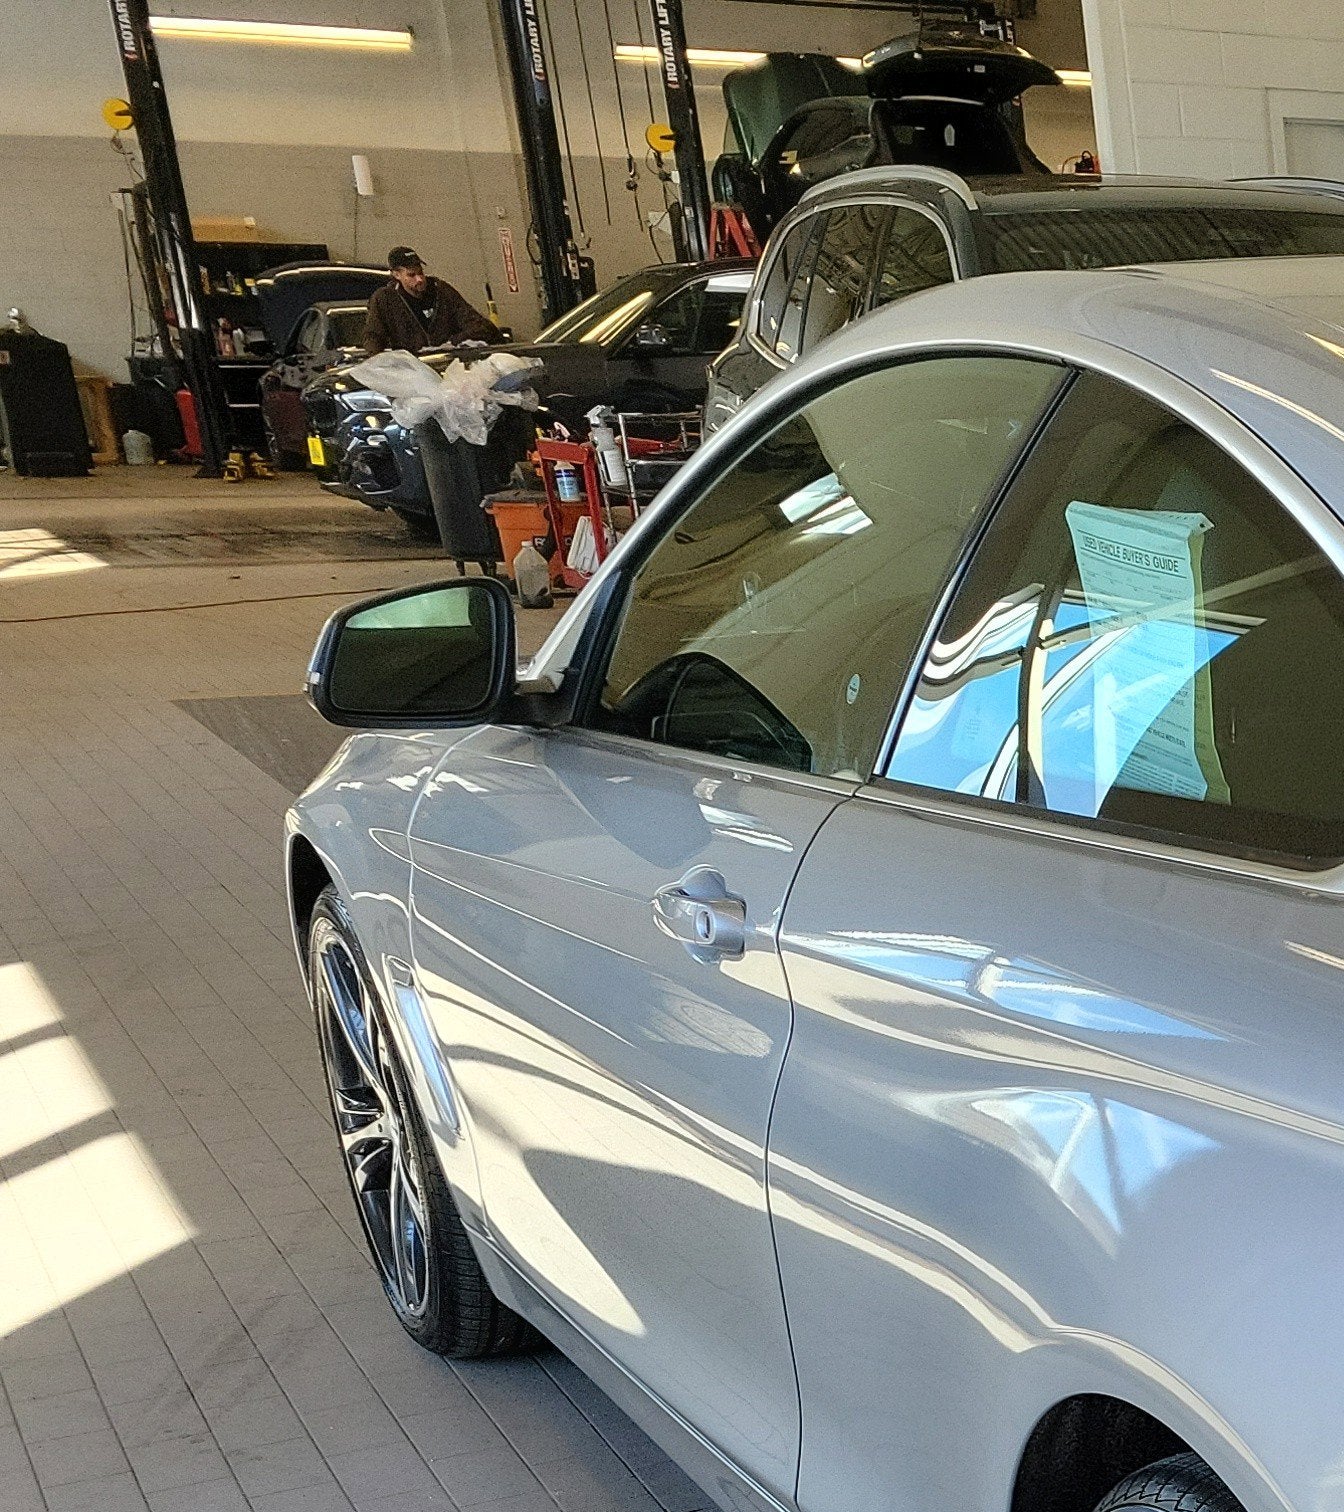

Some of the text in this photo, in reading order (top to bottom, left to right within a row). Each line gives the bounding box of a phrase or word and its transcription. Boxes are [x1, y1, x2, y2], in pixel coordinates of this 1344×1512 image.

[115, 0, 137, 52] ROTAR
[525, 18, 545, 74] ROTARY
[656, 0, 680, 82] ROTARY LIF
[1099, 540, 1121, 559] VEHICLE
[1122, 547, 1151, 568] BUYER'S
[1152, 556, 1179, 573] GUIDE
